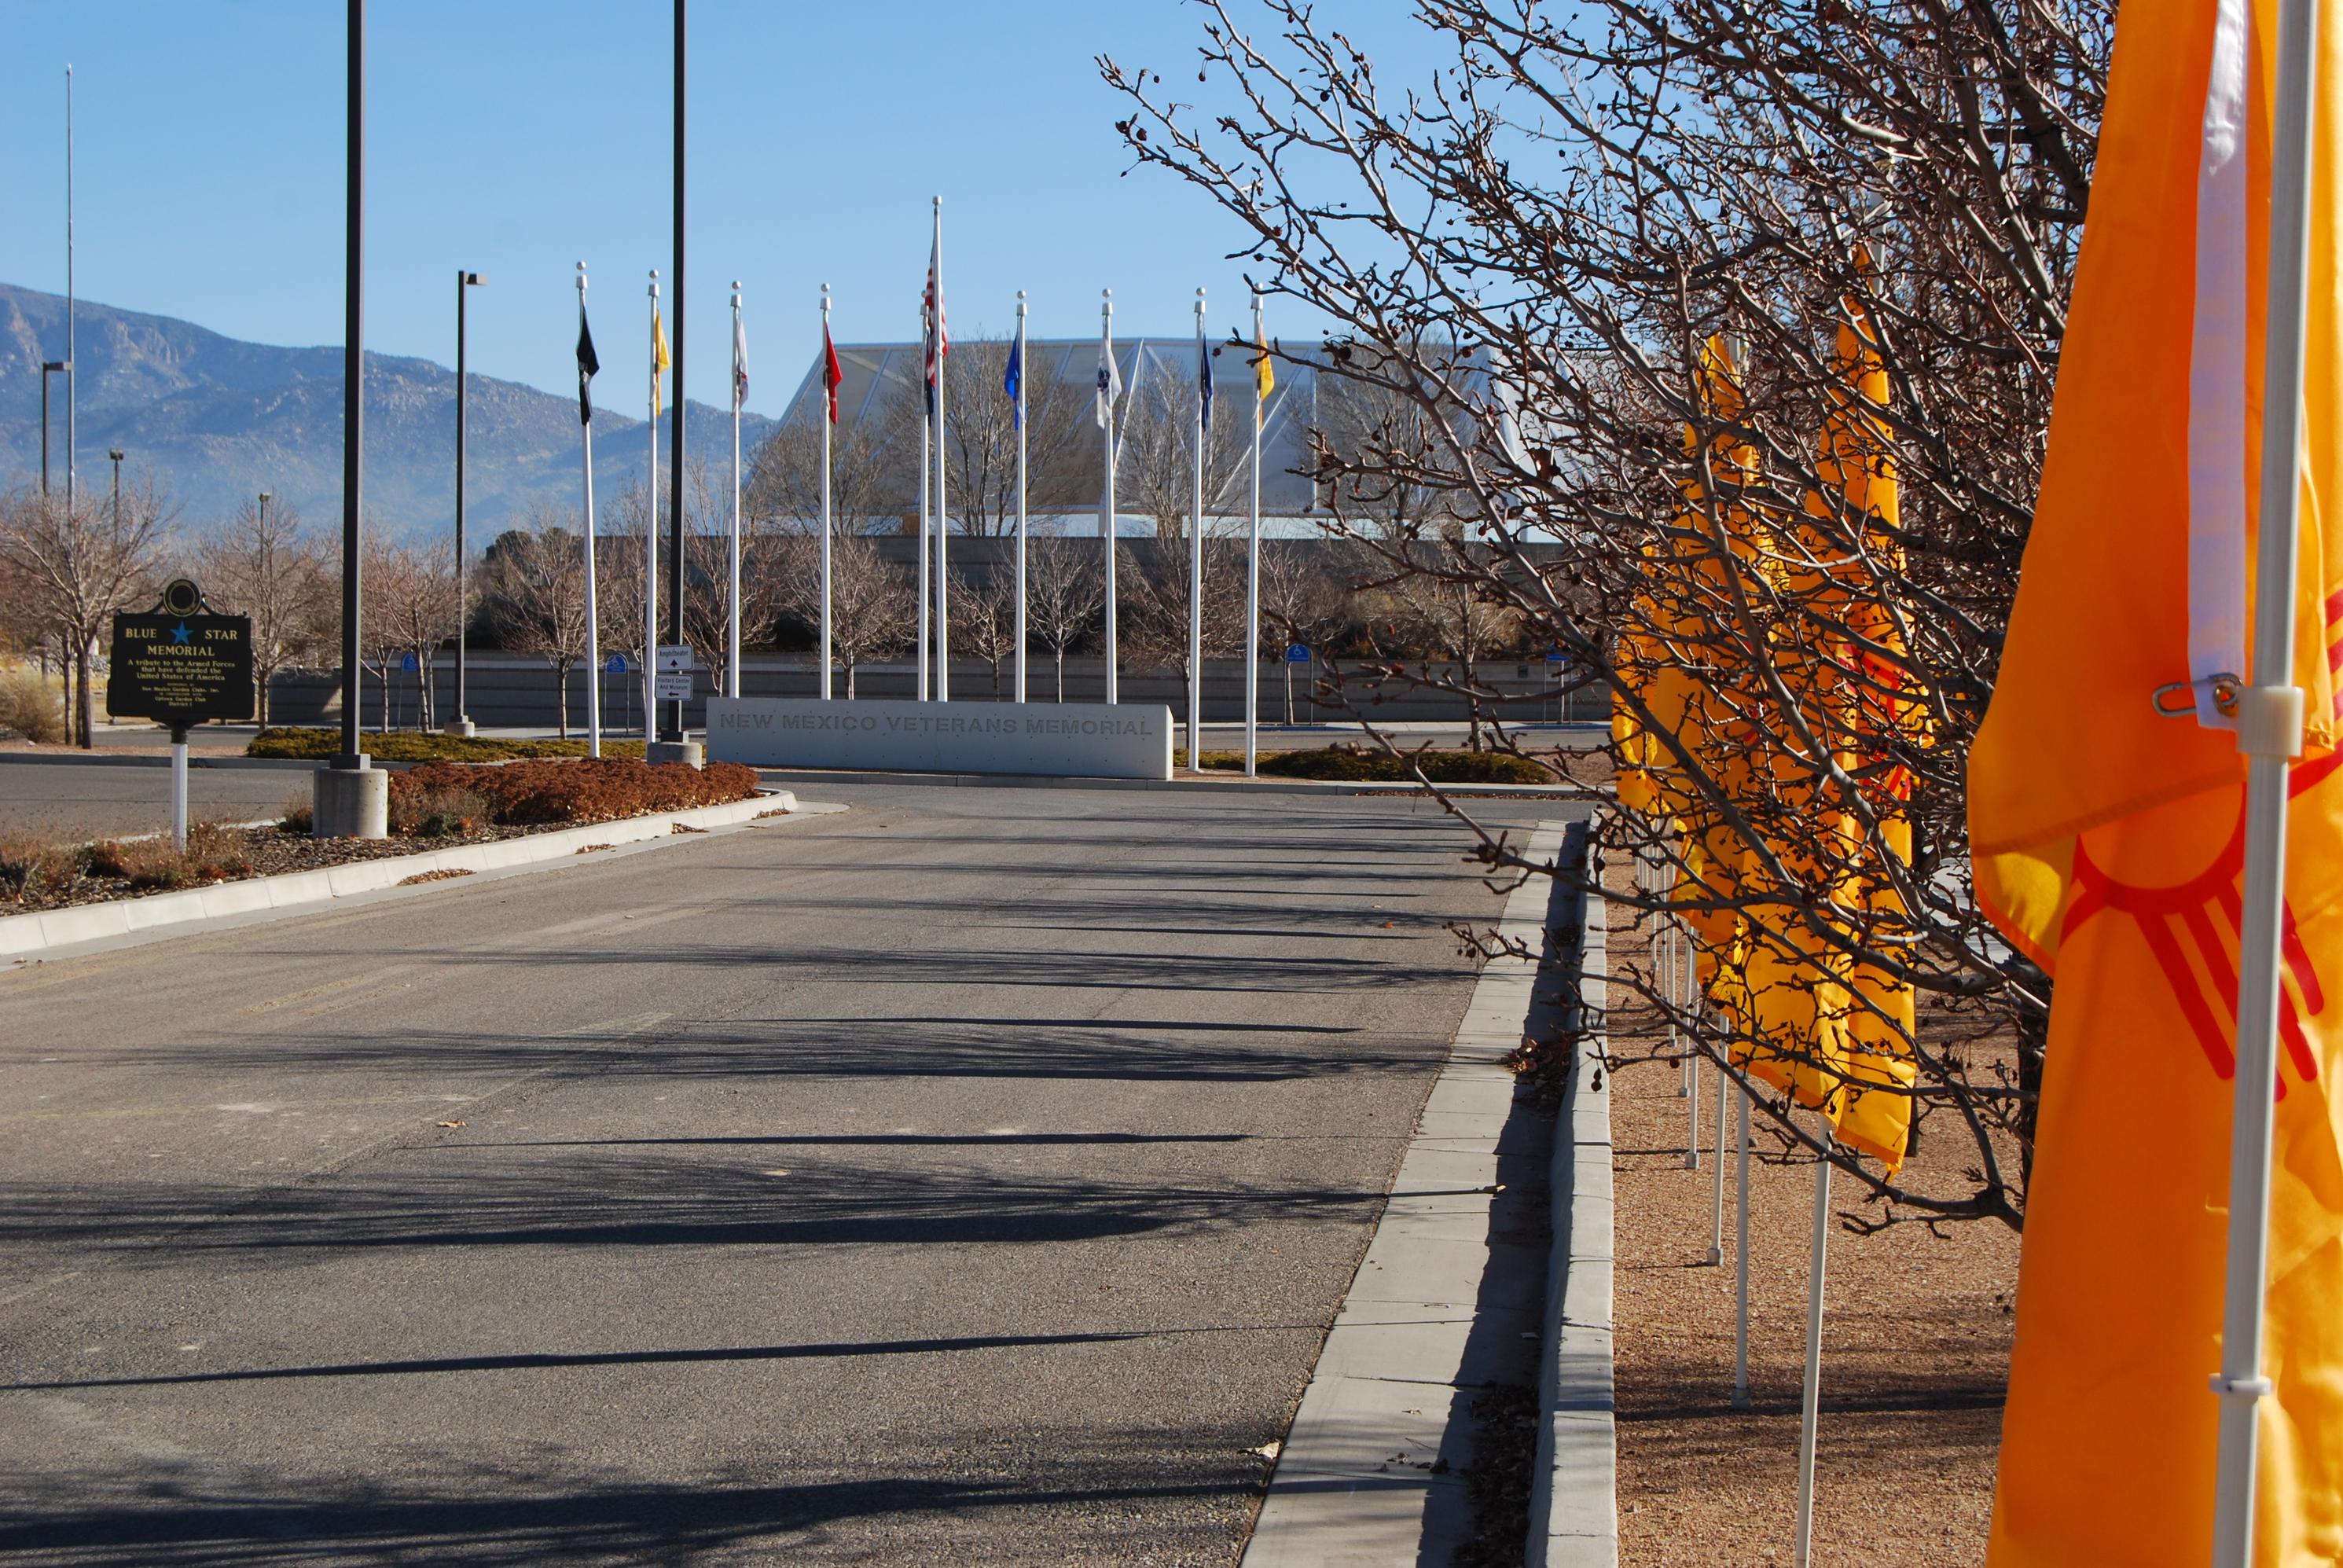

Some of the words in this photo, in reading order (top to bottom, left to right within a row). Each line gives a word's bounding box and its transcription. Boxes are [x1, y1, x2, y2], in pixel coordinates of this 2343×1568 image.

[126, 628, 156, 638] BLUE
[205, 630, 237, 640] STAR
[147, 644, 215, 656] MEMORIAL
[720, 714, 773, 729] NEW
[782, 714, 876, 731] MEXICO
[887, 716, 1017, 733] VETERANS
[1026, 719, 1152, 736] MEMORIAL
